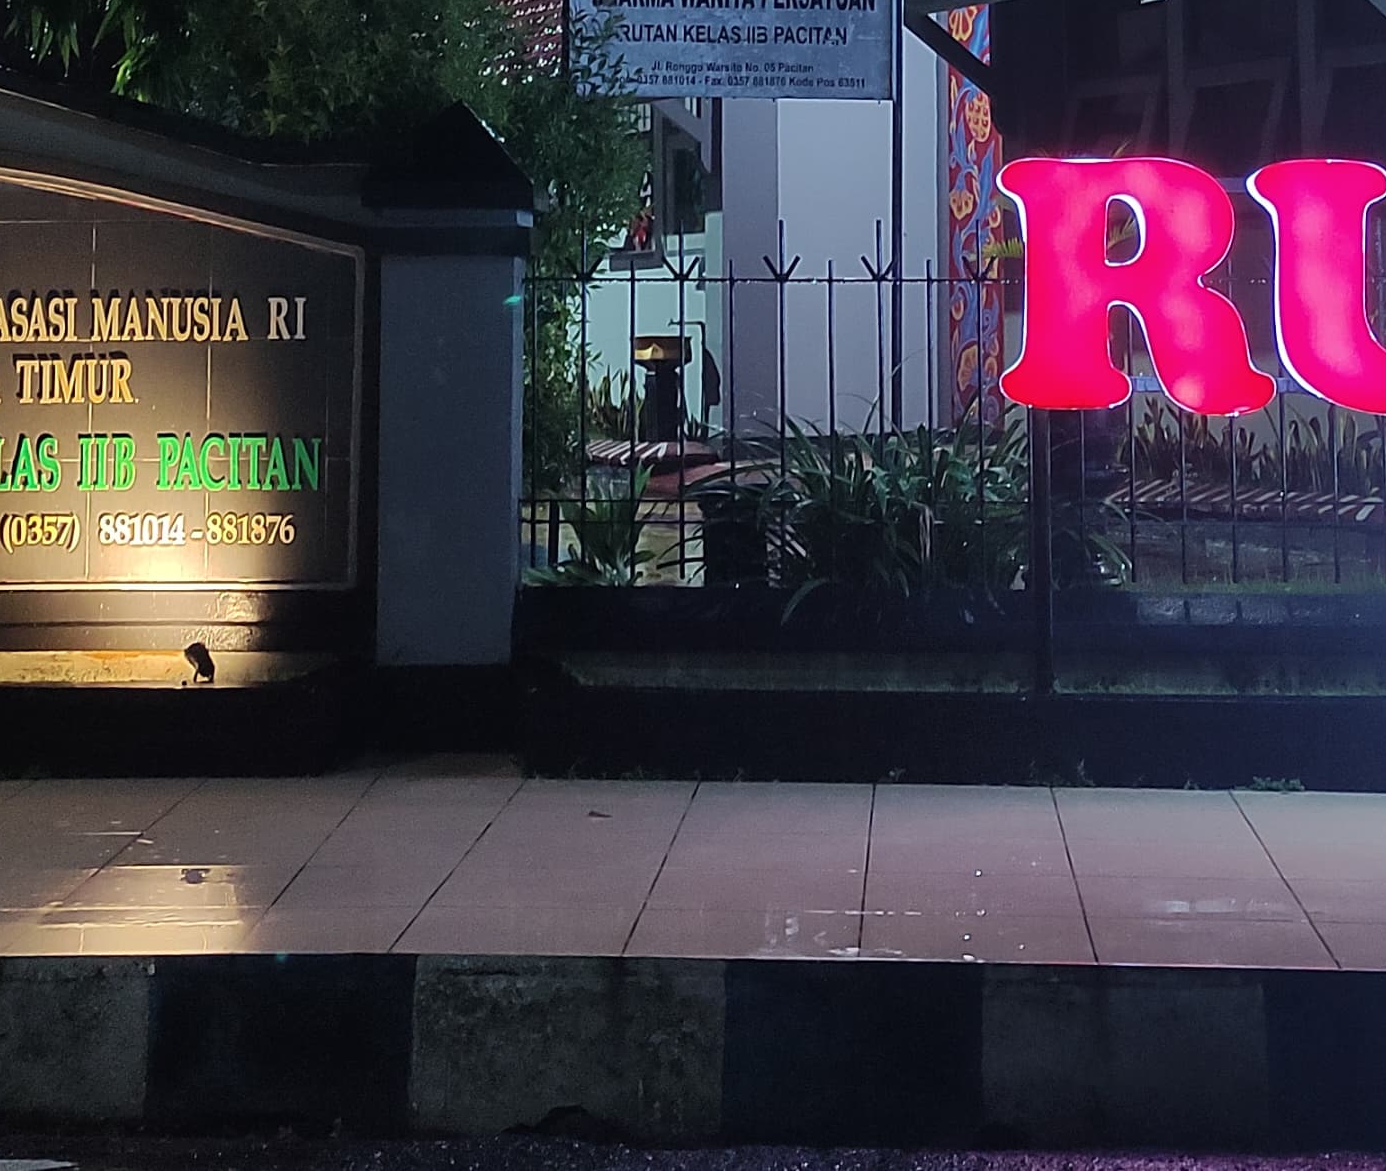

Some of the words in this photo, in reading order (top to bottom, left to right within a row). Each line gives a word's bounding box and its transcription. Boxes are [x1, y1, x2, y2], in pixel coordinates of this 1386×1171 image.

[619, 24, 677, 43] RUTAN
[683, 24, 741, 44] KELAS
[774, 26, 847, 45] PACITAN
[665, 61, 703, 74] Ronggo
[706, 62, 743, 72] Warsito
[764, 63, 776, 73] 05
[778, 63, 814, 73] Pacitan
[789, 77, 814, 87] Kode
[817, 77, 835, 88] Pos
[91, 297, 249, 341] MANUSIA
[267, 296, 306, 340] RI
[77, 437, 137, 493] IIB
[156, 435, 323, 492] PACITAN
[2, 514, 81, 554] (0357)
[98, 516, 185, 546] 881014
[206, 516, 296, 546] 881876
